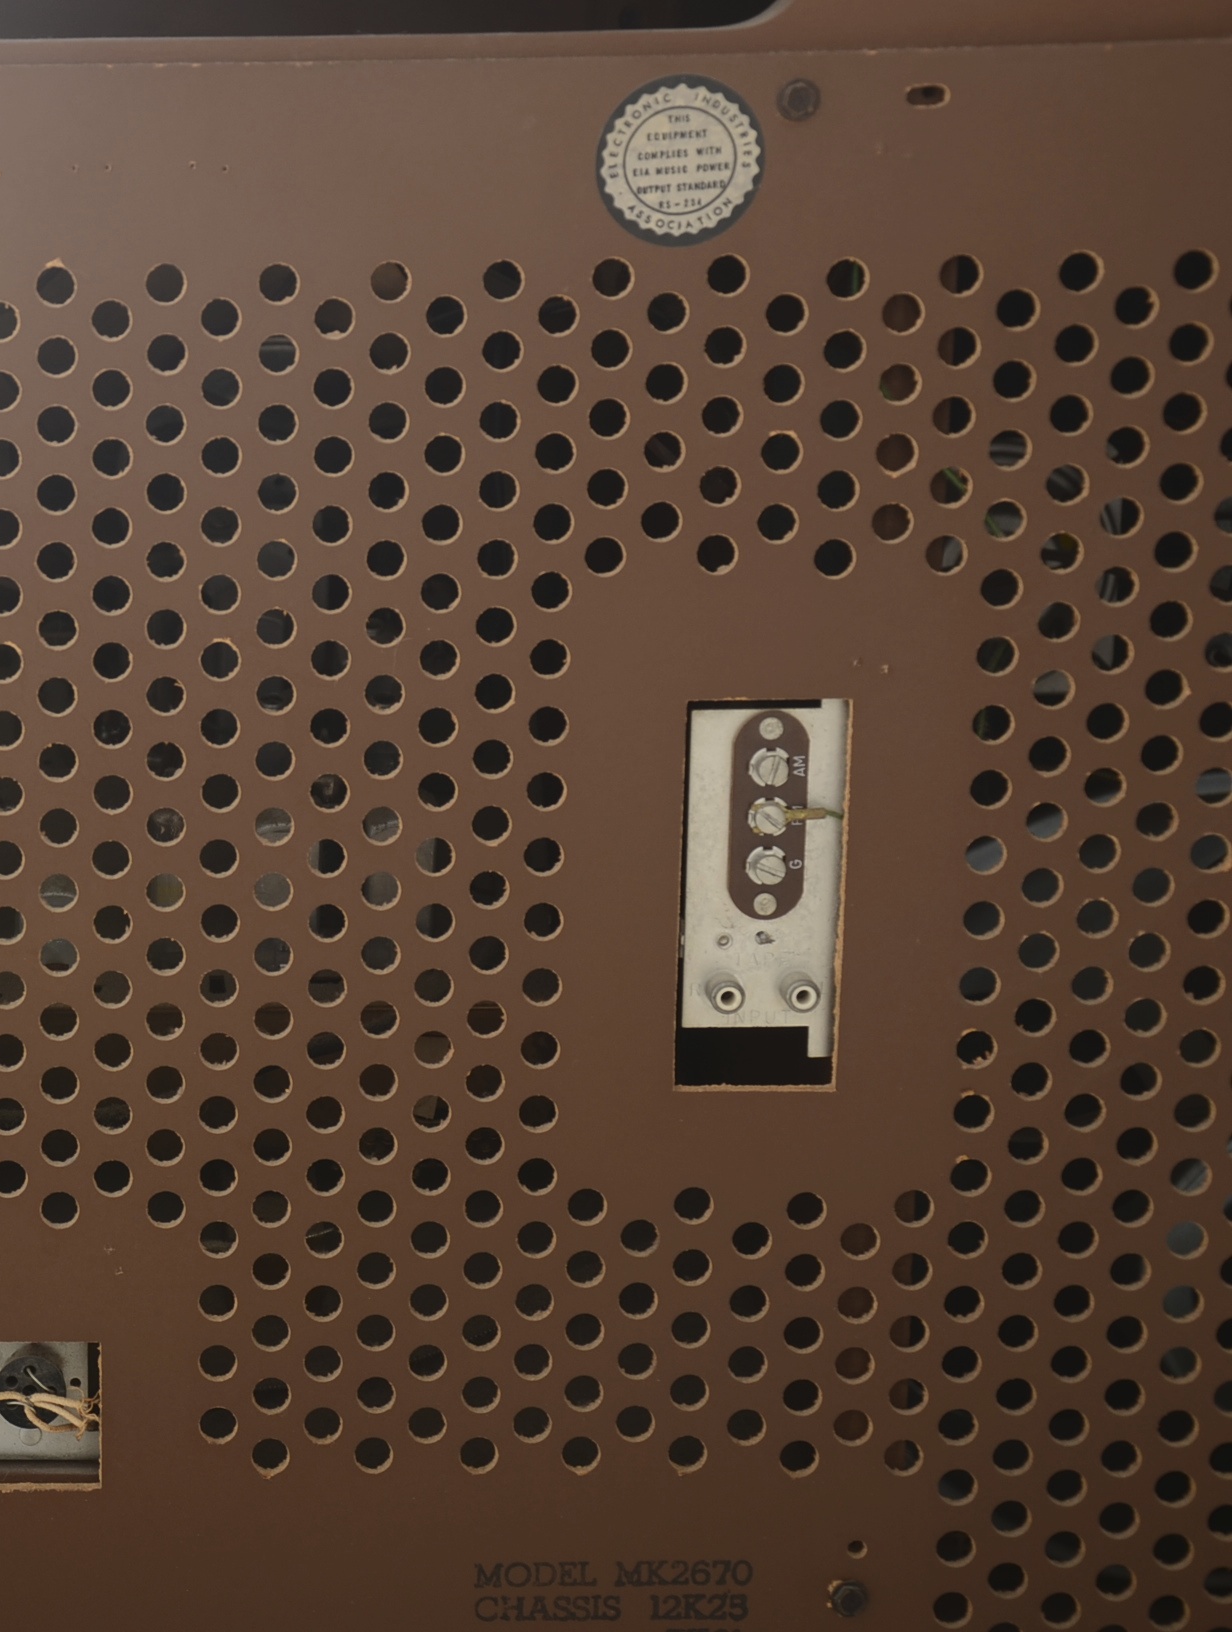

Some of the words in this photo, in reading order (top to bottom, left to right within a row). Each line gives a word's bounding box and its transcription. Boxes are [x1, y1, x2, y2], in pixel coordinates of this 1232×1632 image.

[669, 114, 691, 124] THIS
[608, 92, 672, 179] ELECTRONIC
[694, 92, 752, 169] INDUSTRIES
[647, 129, 708, 142] EQUIPMENT
[638, 149, 688, 161] COMPLIES
[696, 146, 722, 157] WITH
[656, 165, 688, 175] MUSIC
[696, 162, 730, 173] POWER
[636, 184, 671, 195] OUTPUT
[676, 180, 726, 193] STANDARD
[627, 197, 733, 230] ASSOCIATION
[792, 754, 807, 777] AM
[788, 858, 803, 871] G
[474, 1561, 597, 1588] MODEL
[614, 1560, 753, 1587] MK2670
[474, 1595, 622, 1622] CHASSIS
